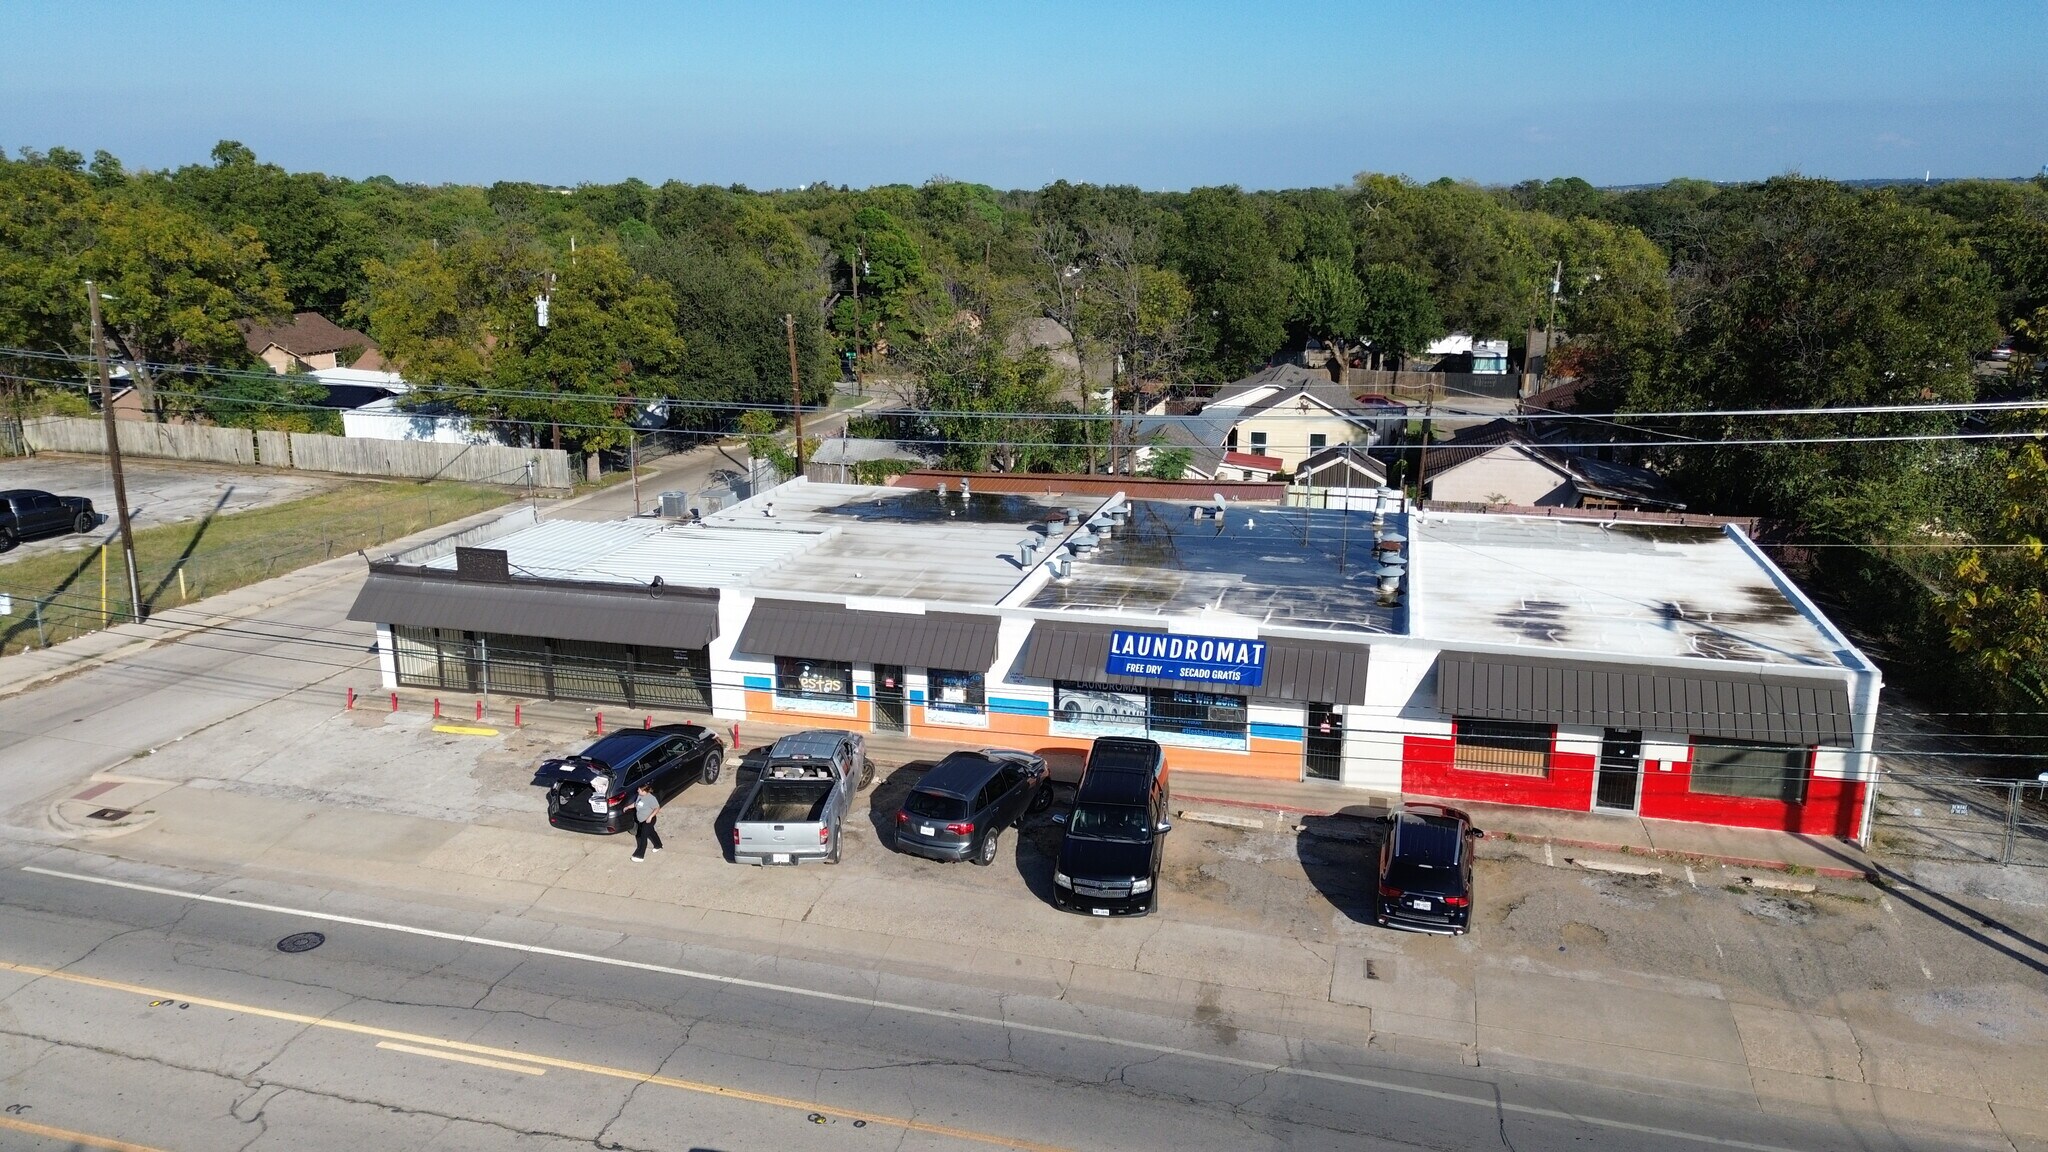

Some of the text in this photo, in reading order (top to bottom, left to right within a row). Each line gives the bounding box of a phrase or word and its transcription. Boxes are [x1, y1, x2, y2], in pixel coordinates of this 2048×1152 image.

[1111, 633, 1265, 665] LAUNDROMAT
[1125, 663, 1145, 674] FREE
[1145, 664, 1163, 675] DRY
[1179, 667, 1211, 679] SECADO
[1211, 670, 1242, 681] GRATIS
